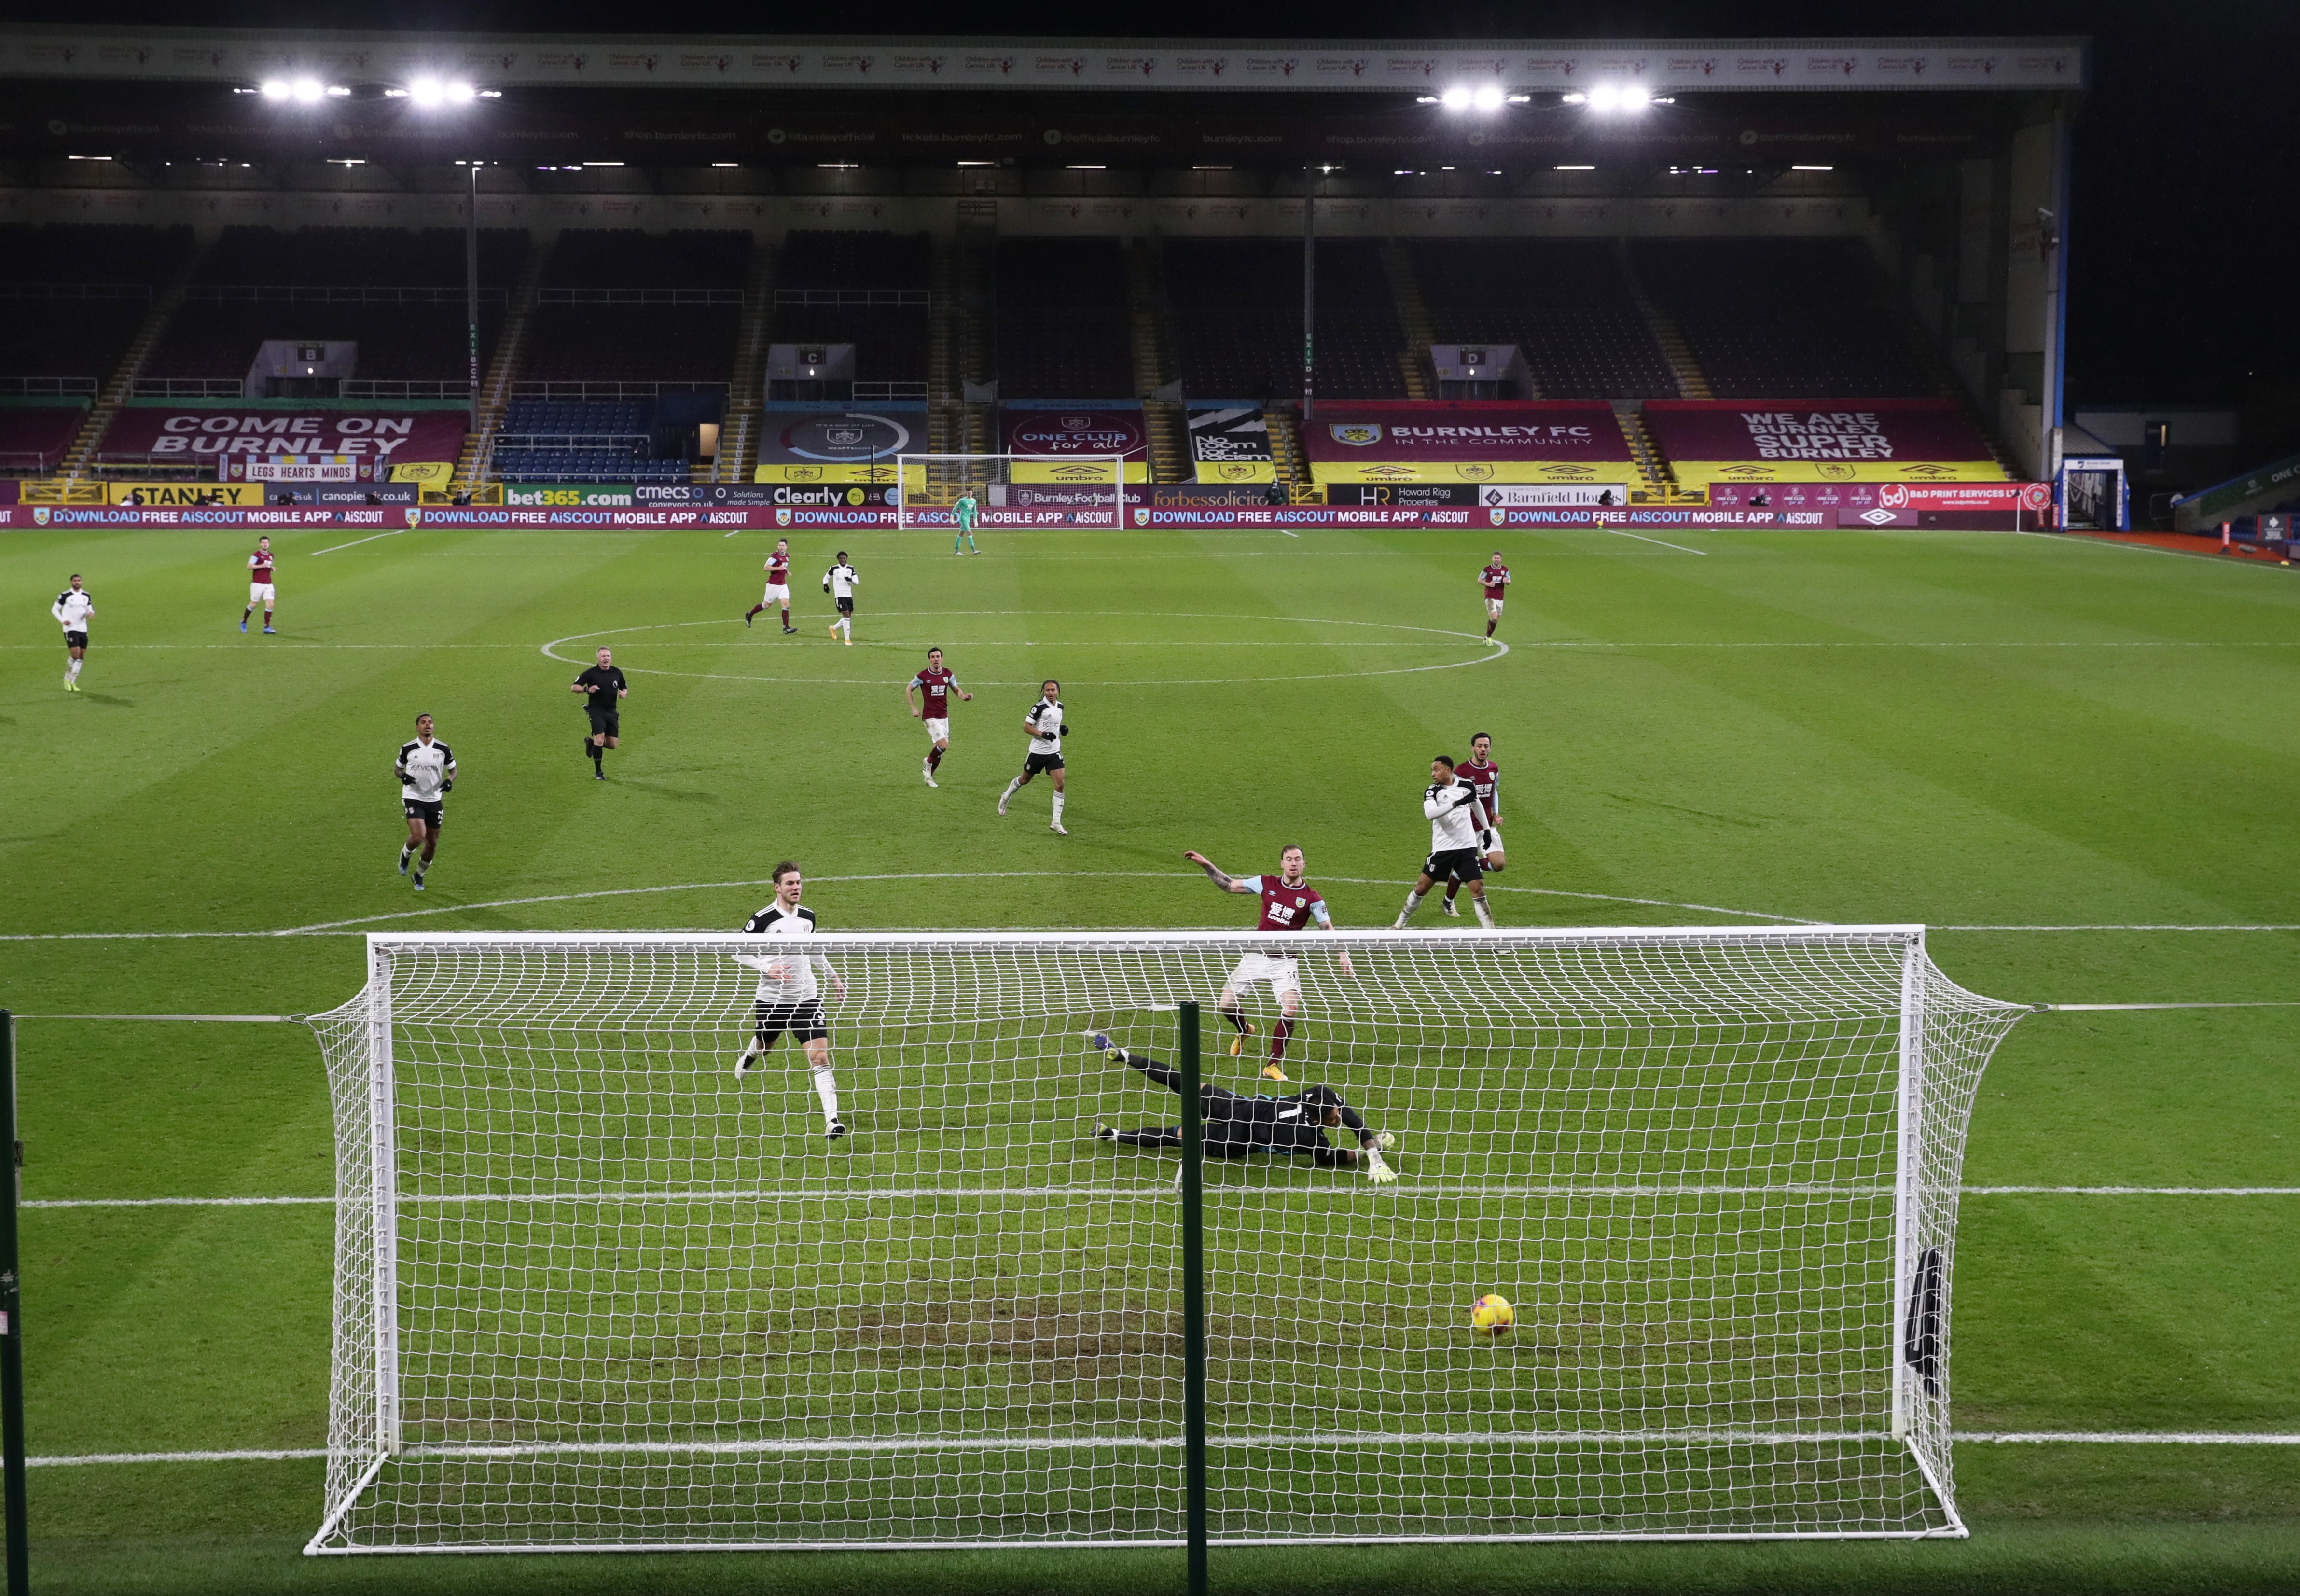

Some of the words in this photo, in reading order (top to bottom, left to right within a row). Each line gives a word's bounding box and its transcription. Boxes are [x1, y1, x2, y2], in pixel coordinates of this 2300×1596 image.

[808, 353, 817, 363] C
[1468, 353, 1478, 364] D
[164, 416, 324, 434] COME
[336, 418, 414, 434] ON
[1740, 413, 1798, 425] WE
[1808, 413, 1879, 425] ARE
[1391, 426, 1540, 437] BURNLEY
[1549, 426, 1592, 437] FC
[1748, 425, 1880, 434] BURNLEY
[151, 436, 409, 454] BURNLEY
[1049, 442, 1082, 450] for
[1093, 440, 1121, 449] all
[1195, 435, 1228, 444] No
[1753, 435, 1892, 449] SUPER
[1199, 452, 1271, 461] racism
[1759, 448, 1894, 458] BURNLEY
[252, 466, 274, 478] LEGS
[281, 466, 315, 478] HEARTS
[322, 467, 351, 478] MINDS
[507, 489, 632, 506] bet365.com
[636, 486, 690, 499] cmecs
[773, 486, 843, 507] Clearly
[1399, 487, 1430, 496] Howard
[1433, 487, 1451, 498] Rigg
[1508, 491, 1570, 503] Barnfield
[1882, 488, 1904, 506] bd
[1034, 493, 1074, 505] Burnley
[54, 510, 140, 523] DOWNLOAD
[142, 511, 178, 523] FREE
[181, 511, 245, 523] AiSCOUT
[247, 511, 301, 523] MOBILE
[304, 511, 332, 523] APP
[344, 511, 383, 523] AiSCOUT
[424, 511, 509, 523] DOWNLOAD
[511, 512, 546, 523] FREE
[549, 512, 612, 524] AiSCOUT
[614, 513, 666, 524] MOBILE
[670, 513, 697, 524] APP
[709, 512, 748, 524] AiSCOUT
[795, 512, 877, 523] DOWNLOAD
[982, 512, 1033, 523] MOBILE
[1036, 512, 1063, 523] APP
[1075, 511, 1113, 523] AiSCOUT
[1153, 511, 1235, 523] DOWNLOAD
[1237, 512, 1271, 523] FREE
[1274, 511, 1336, 523] AiSCOUT
[1338, 511, 1389, 523] MOBILE
[1392, 511, 1419, 522] APP
[1431, 511, 1469, 523] AiSCOUT
[1509, 511, 1590, 523] DOWNLOAD
[1593, 512, 1626, 523] FREE
[1629, 511, 1690, 523] AiSCOUT
[1692, 512, 1744, 523] MOBILE
[1747, 512, 1773, 523] APP
[1786, 512, 1823, 524] AiSCOUT
[1269, 902, 1295, 920] 爱博
[1267, 913, 1290, 926] LoveBet
